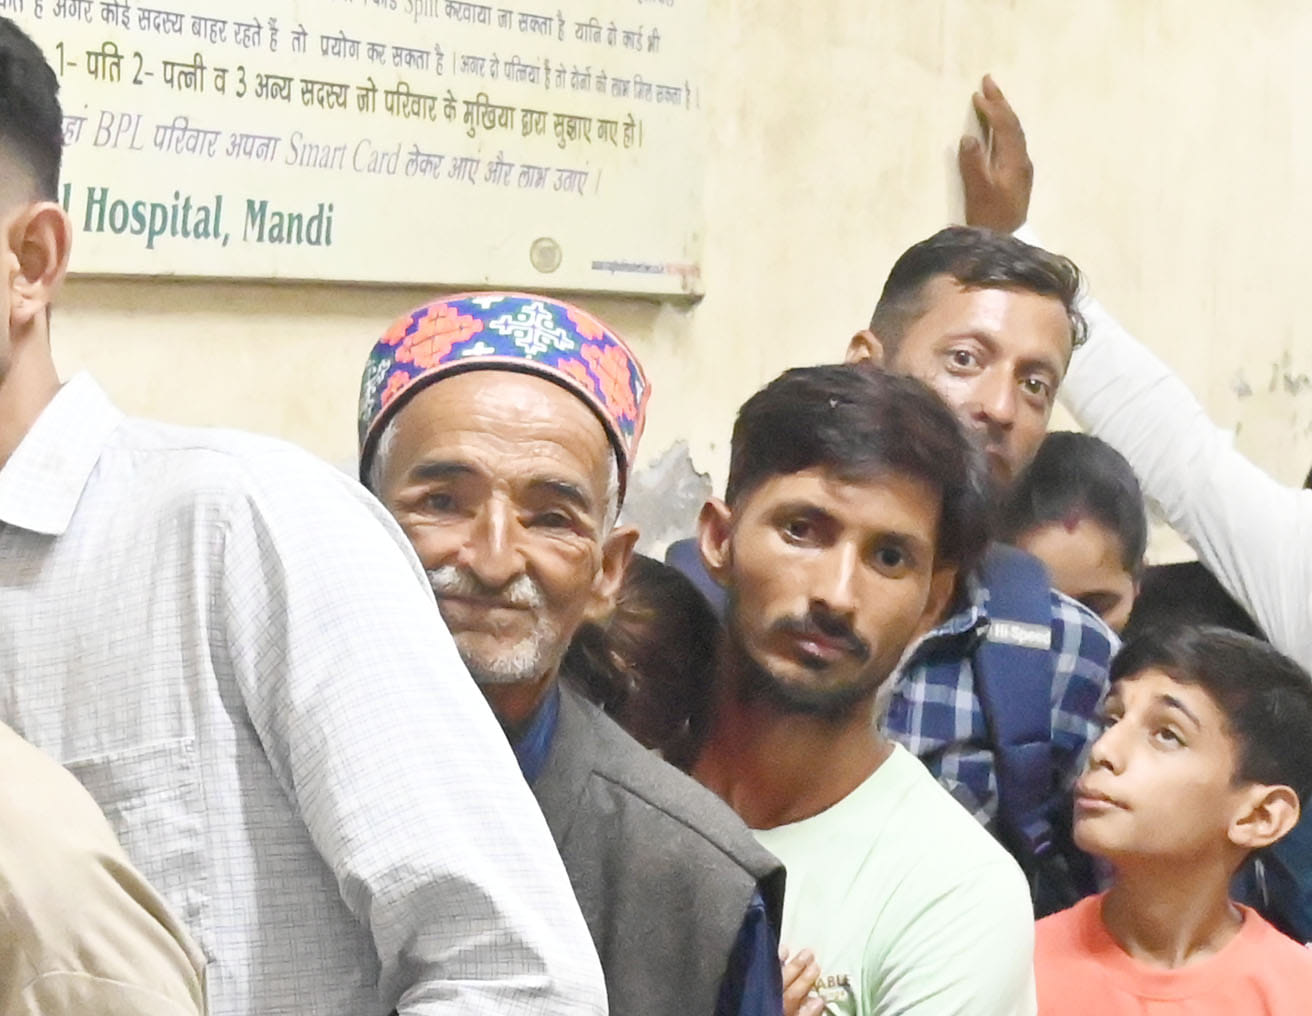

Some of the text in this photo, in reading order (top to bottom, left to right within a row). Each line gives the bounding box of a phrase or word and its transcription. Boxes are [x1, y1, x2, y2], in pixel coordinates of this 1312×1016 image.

[137, 8, 184, 36] सदस्य
[191, 15, 228, 45] बाहर
[234, 17, 264, 49] रहते
[291, 24, 308, 54] तो
[366, 42, 387, 66] कर
[392, 45, 431, 71] सकता
[445, 0, 492, 26] करवाया
[518, 12, 554, 36] सकता
[86, 41, 124, 83] पति
[162, 52, 207, 93] पत्नी
[213, 67, 229, 95] व
[235, 65, 247, 98] 3
[255, 72, 293, 103] अन्य
[300, 78, 350, 110] सदस्य
[356, 76, 378, 114] जो
[384, 80, 438, 122] परिवार
[443, 89, 458, 123] के
[462, 92, 517, 138] मुखिया
[62, 104, 88, 147] हां
[93, 110, 144, 150] BPL
[154, 115, 221, 158] परिवार
[226, 132, 282, 162] अपना
[285, 130, 348, 171] Smart
[352, 138, 402, 178] Card
[405, 146, 445, 178] लेकर
[484, 150, 516, 187] और
[83, 184, 230, 249] Hospital,
[243, 198, 335, 247] Mandi
